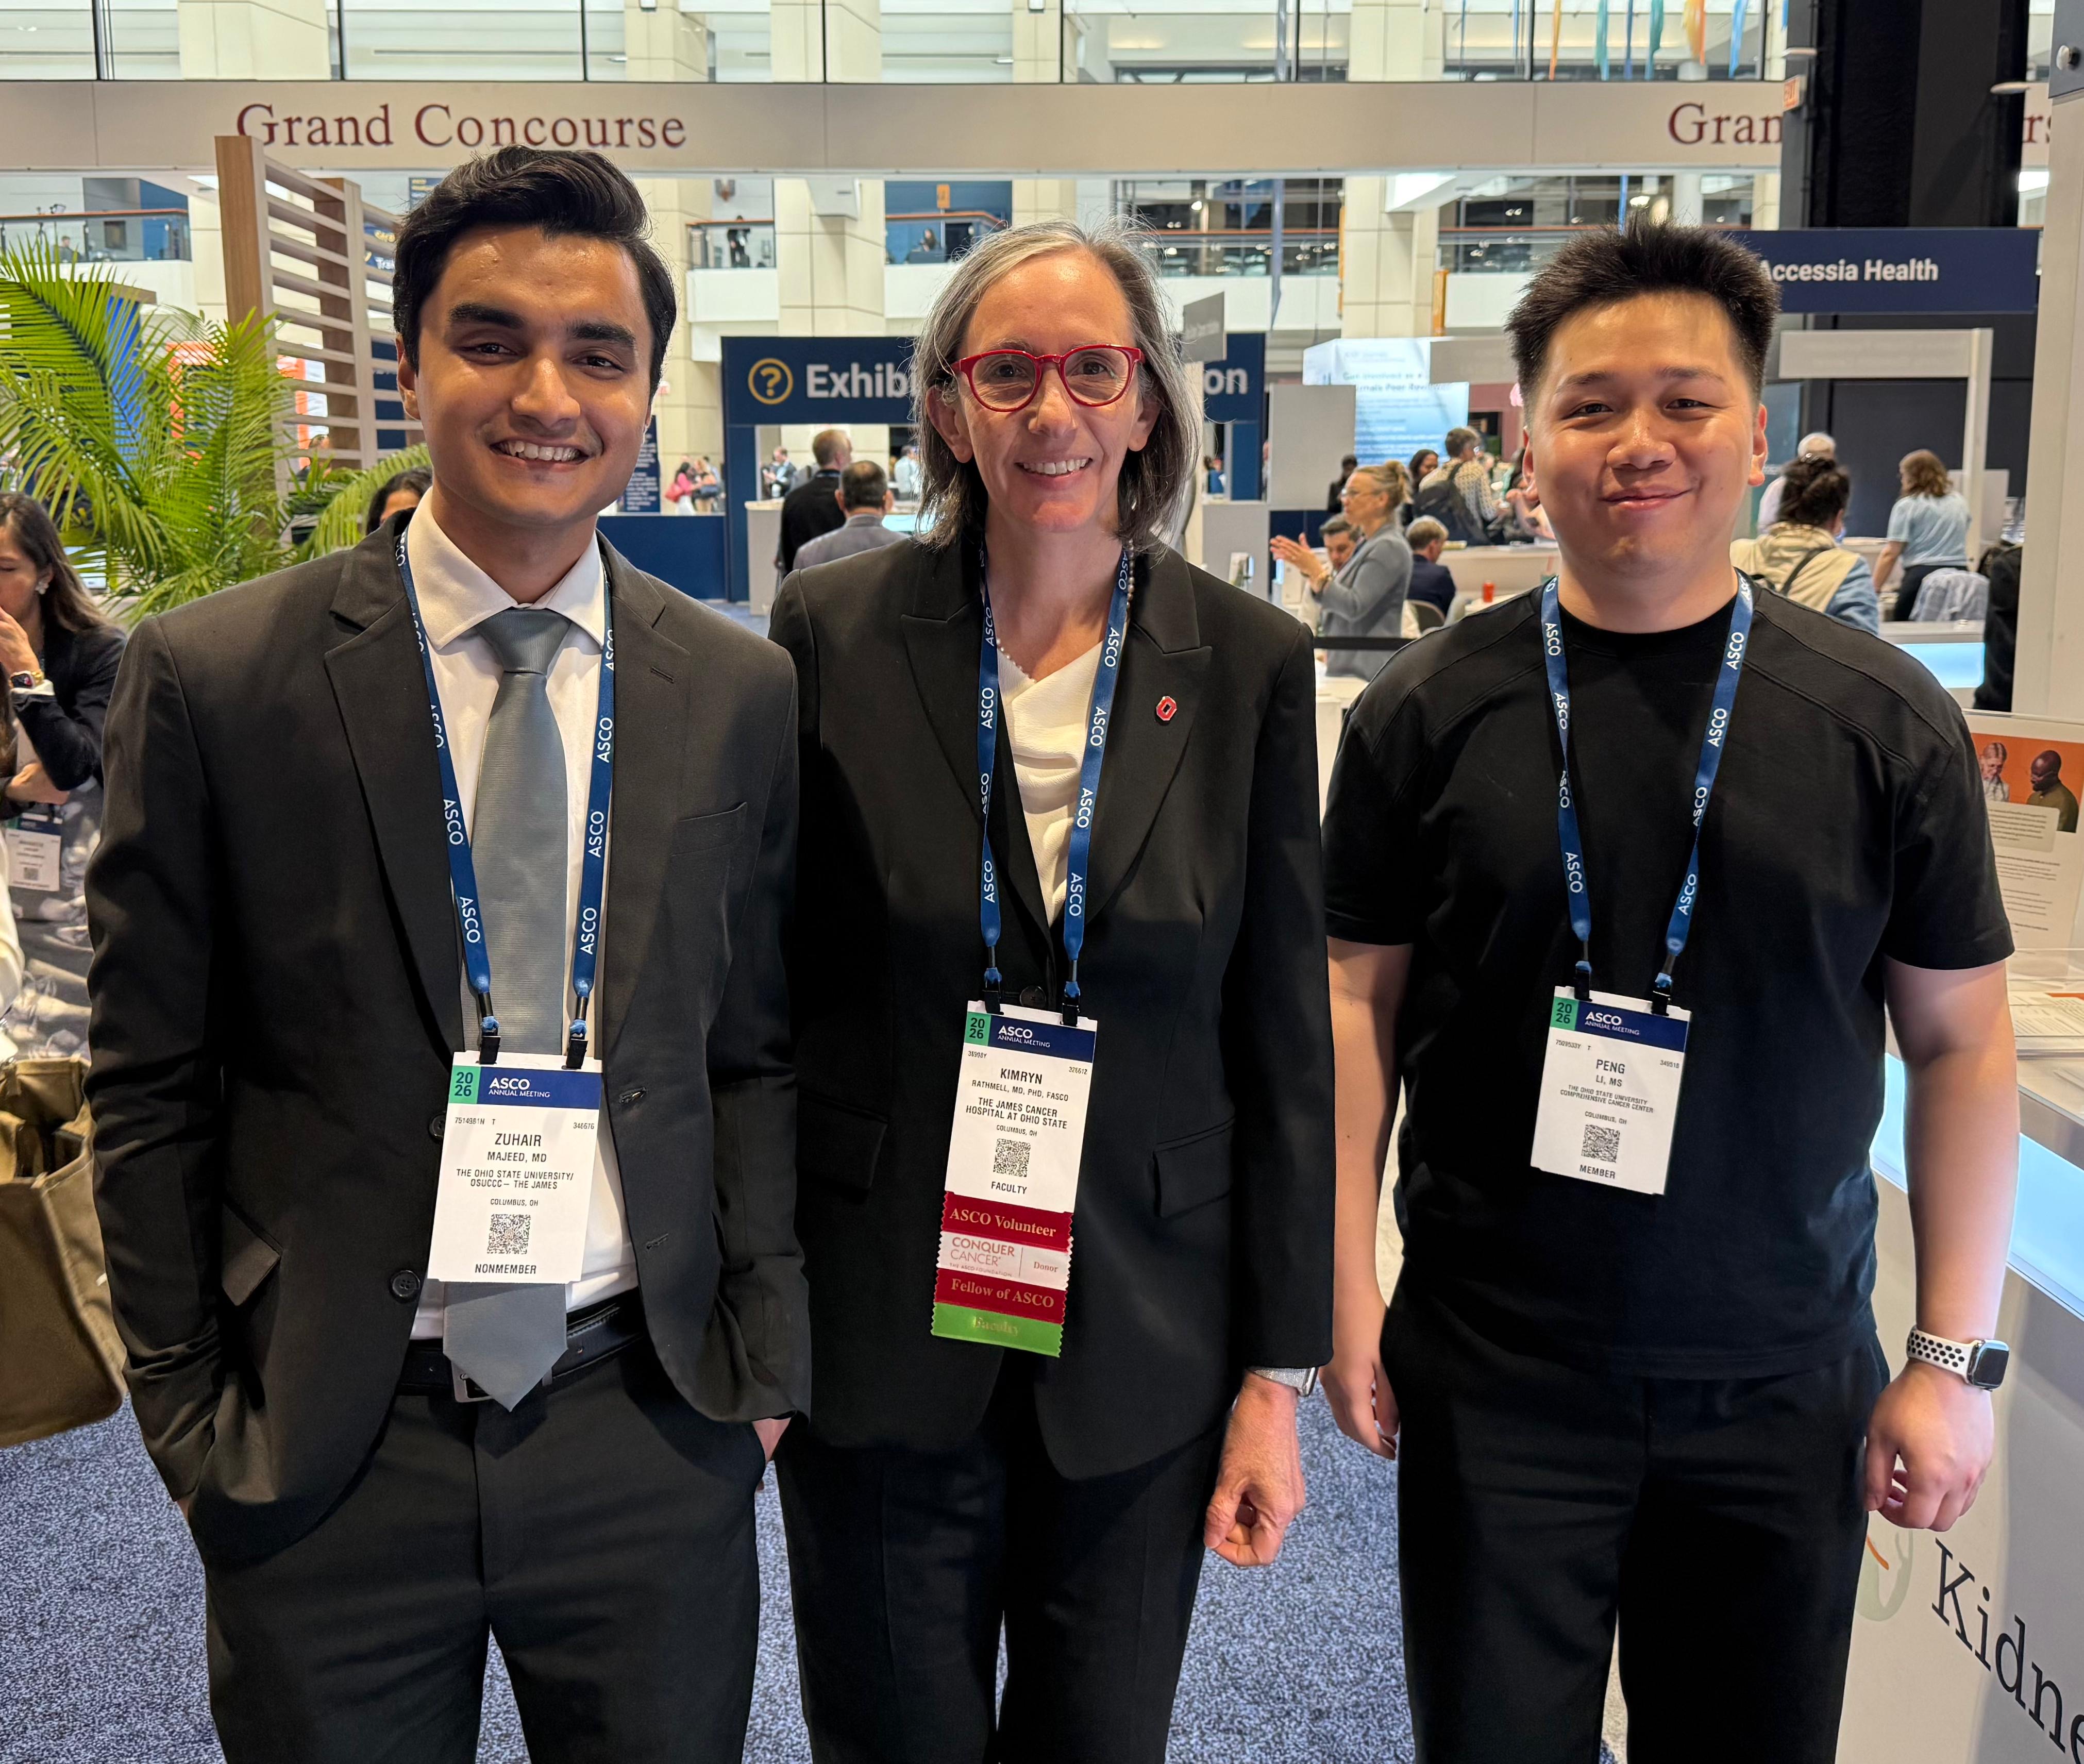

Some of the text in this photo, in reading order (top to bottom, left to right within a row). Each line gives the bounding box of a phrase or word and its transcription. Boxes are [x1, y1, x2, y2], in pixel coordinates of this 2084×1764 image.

[237, 103, 686, 149] Grand Concourse
[1668, 103, 1782, 145] Gran
[1759, 258, 1938, 281] Accessia Health
[806, 362, 913, 399] Exhib
[1204, 367, 1248, 395] on
[985, 607, 995, 647] ASCO
[1104, 627, 1120, 667] ASCO
[1545, 623, 1561, 656] ASCO
[1726, 632, 1744, 670] ASCO
[981, 687, 994, 729] ASCO
[1554, 692, 1568, 730] ASCO
[1090, 706, 1107, 747] ASCO
[1707, 708, 1727, 748] ASCO
[596, 717, 613, 763] ASCO
[1077, 787, 1093, 828] ASCO
[1692, 786, 1707, 827] ASCO
[443, 798, 464, 846] ASCO
[588, 811, 604, 858] ASCO
[984, 860, 995, 903] ASCO
[1565, 852, 1583, 893] ASCO
[1068, 872, 1083, 917] ASCO
[1677, 873, 1696, 916] ASCO
[460, 896, 480, 944] ASCO
[579, 907, 597, 955] ASCO
[1555, 1013, 1570, 1024] 26
[1557, 1002, 1572, 1014] 20
[1586, 1011, 1622, 1026] ASCO
[969, 1029, 984, 1039] 26
[971, 1018, 985, 1029] 20
[998, 1026, 1033, 1039] ASCO
[1585, 1020, 1640, 1035] ANNUAL MEETING
[1023, 1039, 1050, 1047] MEETING
[1000, 1068, 1043, 1084] KIMRYN
[1596, 1059, 1625, 1074] PENG
[456, 1072, 473, 1084] 20
[489, 1078, 530, 1090] ASCO
[1596, 1075, 1622, 1087] LI, MS
[454, 1085, 472, 1096] 26
[972, 1080, 1010, 1093] RATHMELL,
[1028, 1089, 1044, 1098] PHD,
[1047, 1092, 1069, 1101] FASCO
[1595, 1090, 1612, 1099] STATE
[1615, 1095, 1648, 1105] UNIVERSITY
[978, 1098, 1057, 1117] THE JAMES CANCER
[1560, 1089, 1653, 1114] COMPREHENSIVE CANCER CENTER
[966, 1105, 1004, 1118] HOSPITAL
[1020, 1114, 1039, 1124] OHIO
[1043, 1118, 1067, 1129] STATE
[1585, 1111, 1617, 1123] COLUMBUS,
[495, 1133, 542, 1146] ZUHAIR
[997, 1125, 1027, 1135] COLUMBUS,
[487, 1152, 547, 1163] MAJEED, MD
[524, 1171, 574, 1181] UNIVERSITY/
[1579, 1165, 1616, 1180] MEMBER
[470, 1179, 502, 1187] OSUCCC
[531, 1181, 558, 1189] JAMES
[991, 1182, 1027, 1194] FACULTY
[950, 1208, 1056, 1237] ASCO Volunteer
[950, 1249, 999, 1266] CANCER
[952, 1237, 1015, 1257] CONQUER
[475, 1264, 536, 1274] NONMEMBER
[1034, 1262, 1058, 1272] Donor
[951, 1279, 1054, 1307] Fellow of ASCO
